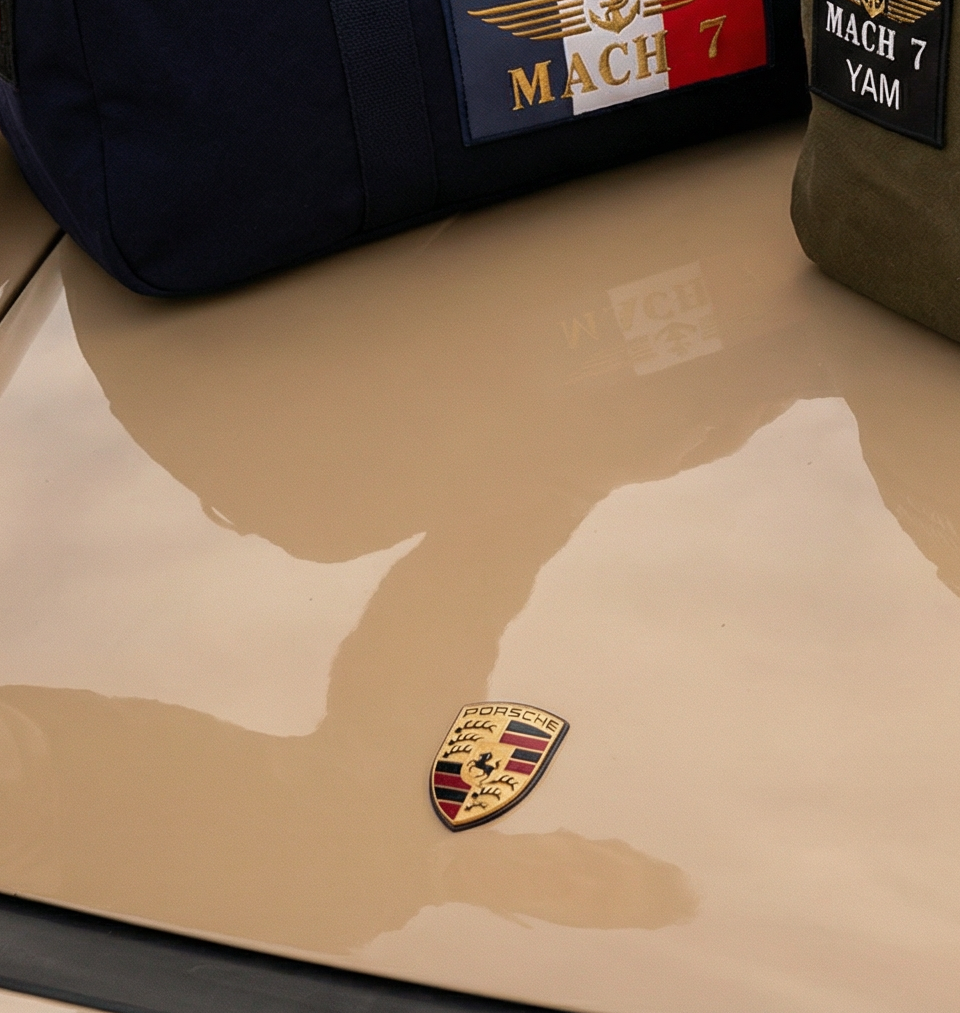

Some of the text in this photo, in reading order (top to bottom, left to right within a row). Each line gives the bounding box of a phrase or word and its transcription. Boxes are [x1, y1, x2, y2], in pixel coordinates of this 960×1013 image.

[508, 15, 727, 111] MACH 7
[825, 0, 927, 71] MACH 7
[846, 58, 900, 111] YAM
[462, 706, 560, 733] PORSCHE
